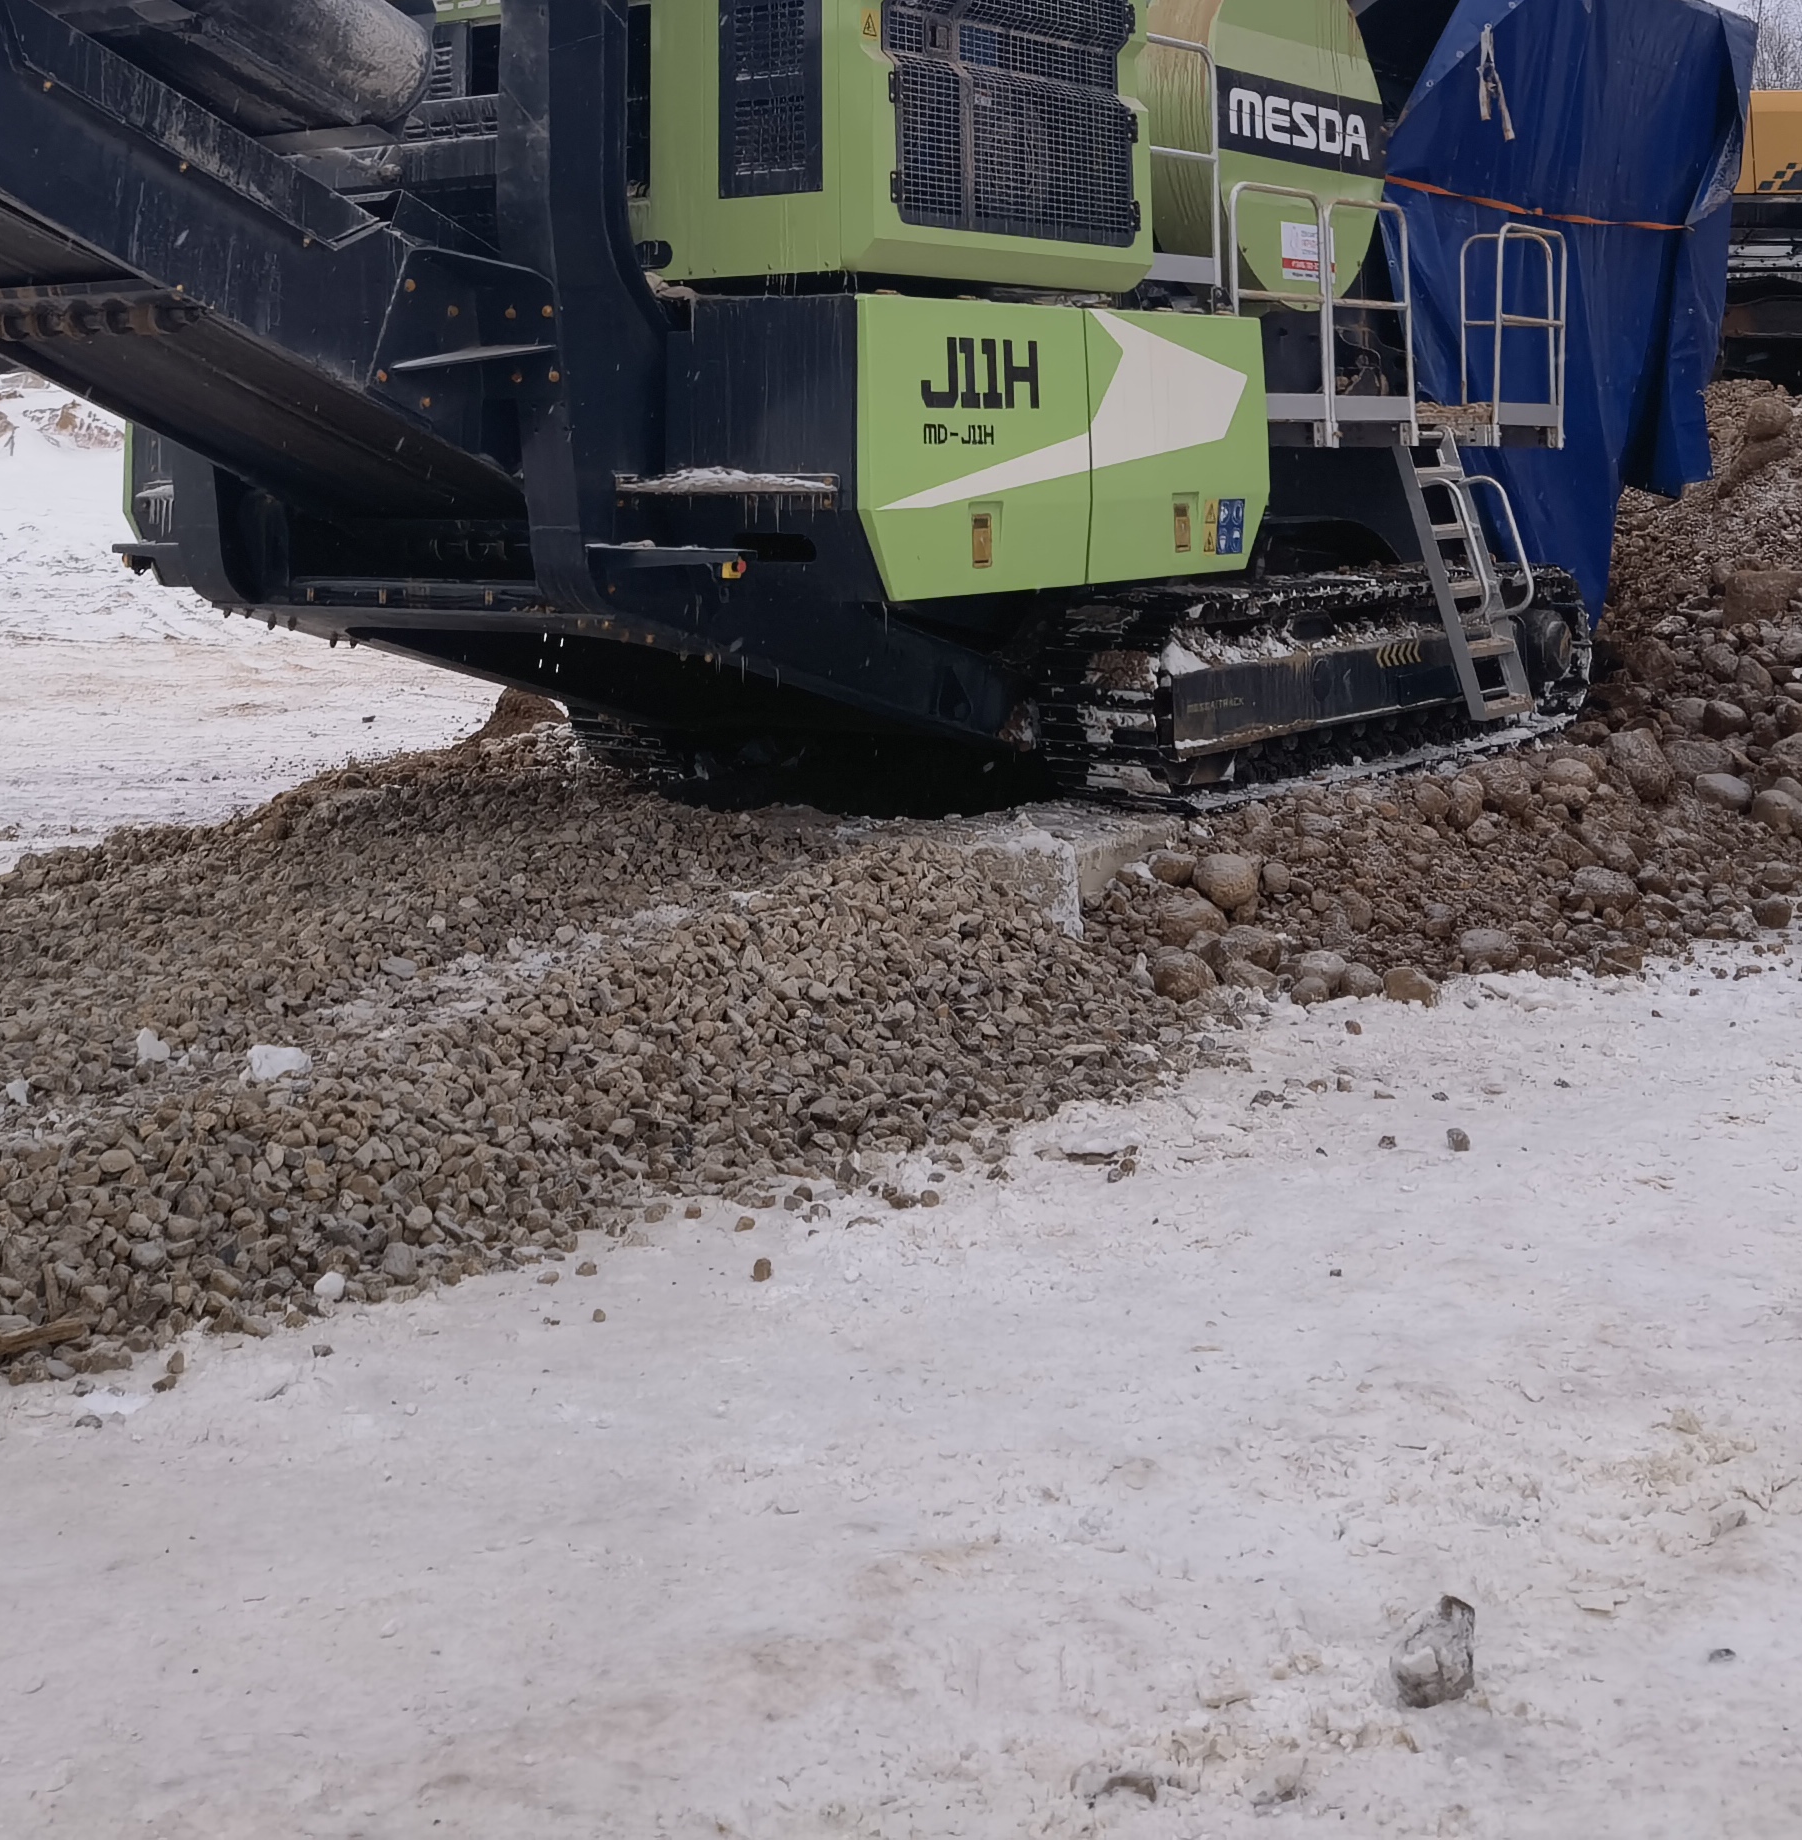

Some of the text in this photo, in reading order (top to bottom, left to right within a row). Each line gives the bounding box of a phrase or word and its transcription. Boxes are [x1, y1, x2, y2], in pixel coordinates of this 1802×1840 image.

[1229, 87, 1371, 161] MESDA
[920, 337, 1040, 409] J11H
[923, 423, 995, 446] MD-J11H
